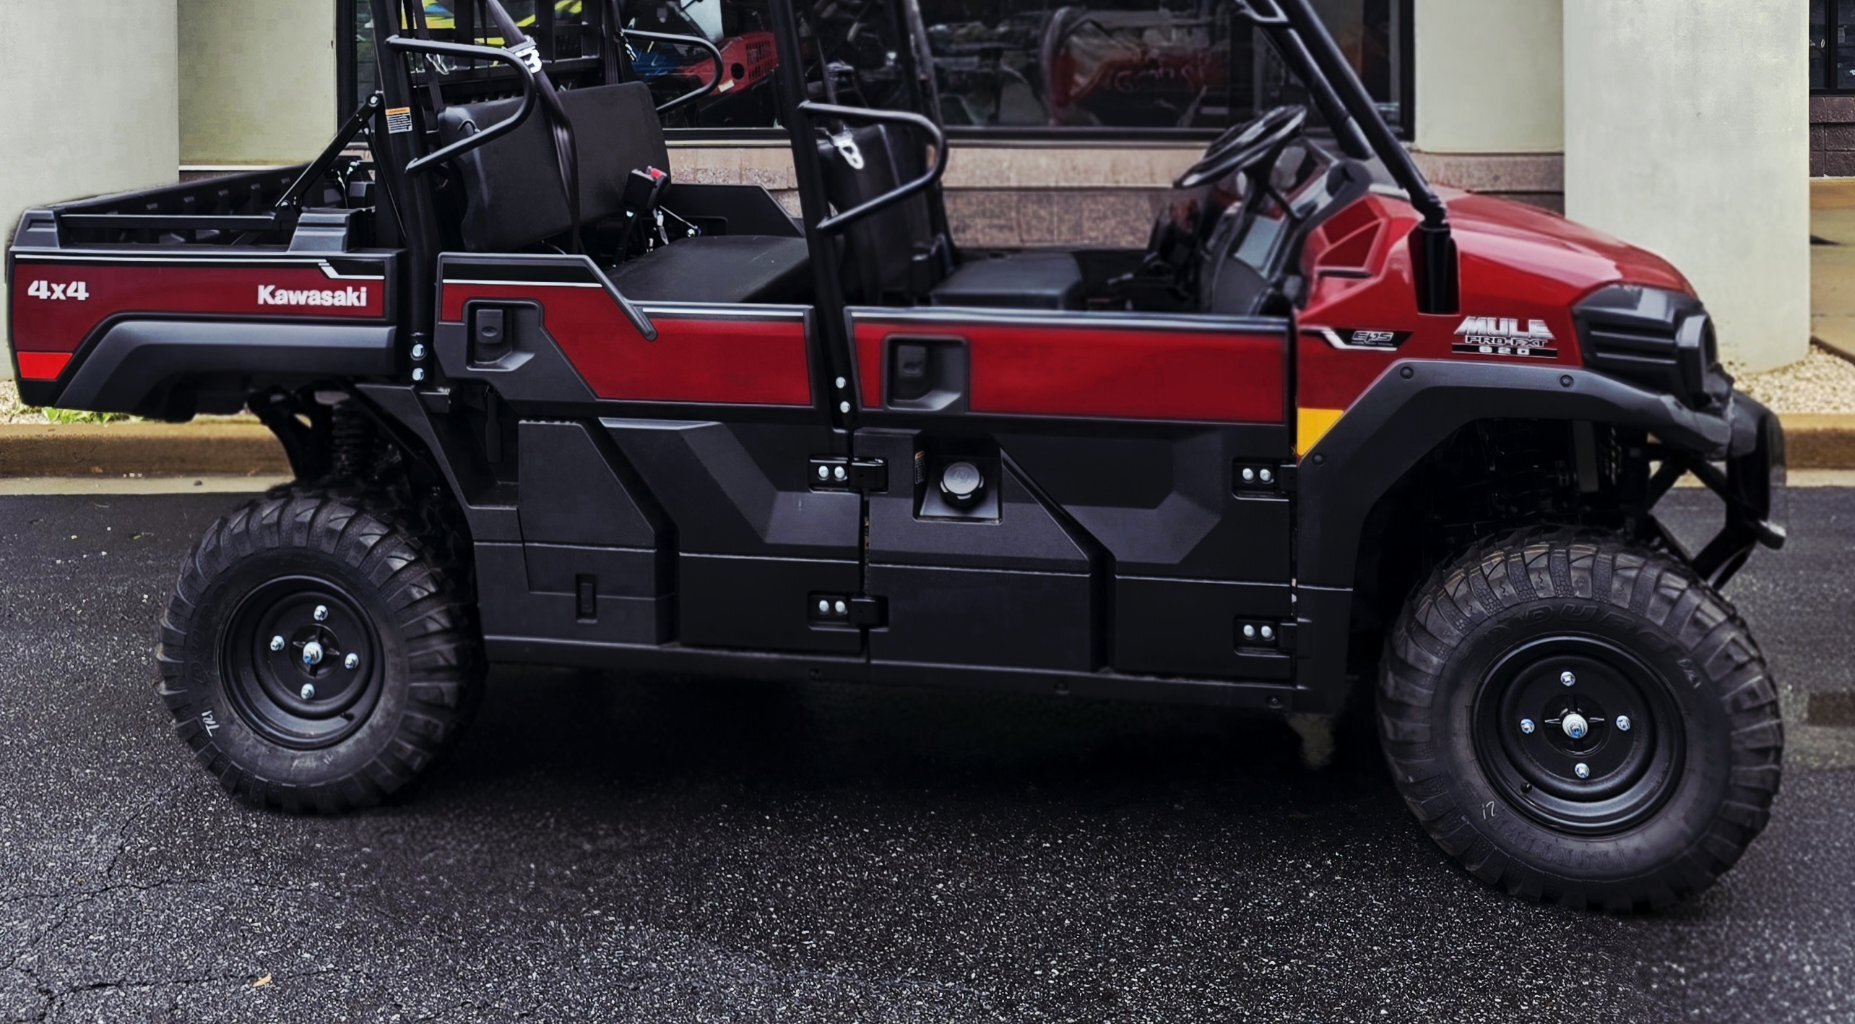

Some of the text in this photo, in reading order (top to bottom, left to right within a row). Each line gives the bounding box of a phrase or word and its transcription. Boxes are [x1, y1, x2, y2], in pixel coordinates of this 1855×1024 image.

[27, 280, 90, 301] 4x4
[257, 285, 367, 307] Kawasaki
[1453, 316, 1555, 338] MULE
[1478, 345, 1530, 356] 820
